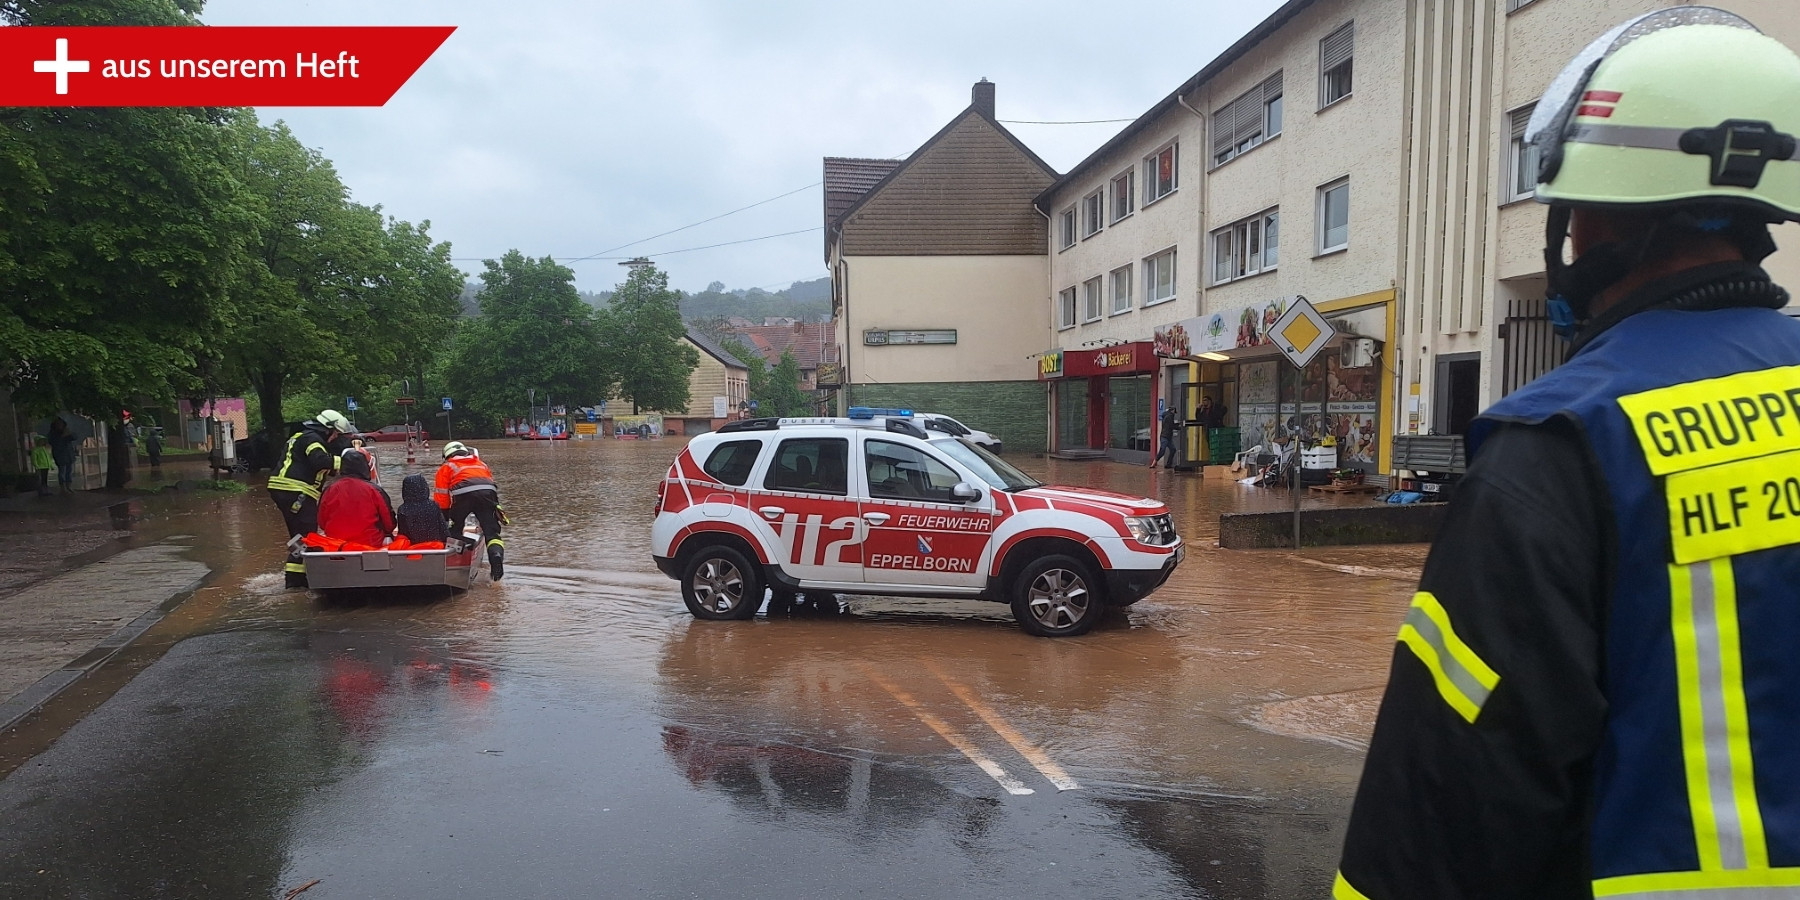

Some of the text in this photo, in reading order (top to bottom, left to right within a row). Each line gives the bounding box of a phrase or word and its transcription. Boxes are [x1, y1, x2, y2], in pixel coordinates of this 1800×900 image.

[1041, 353, 1058, 374] BOST
[1108, 351, 1131, 367] Bäckerei
[1680, 477, 1800, 537] HLF 20
[898, 514, 991, 531] FEUERWEHR
[780, 513, 869, 566] 112
[871, 553, 972, 572] EPPELBORN
